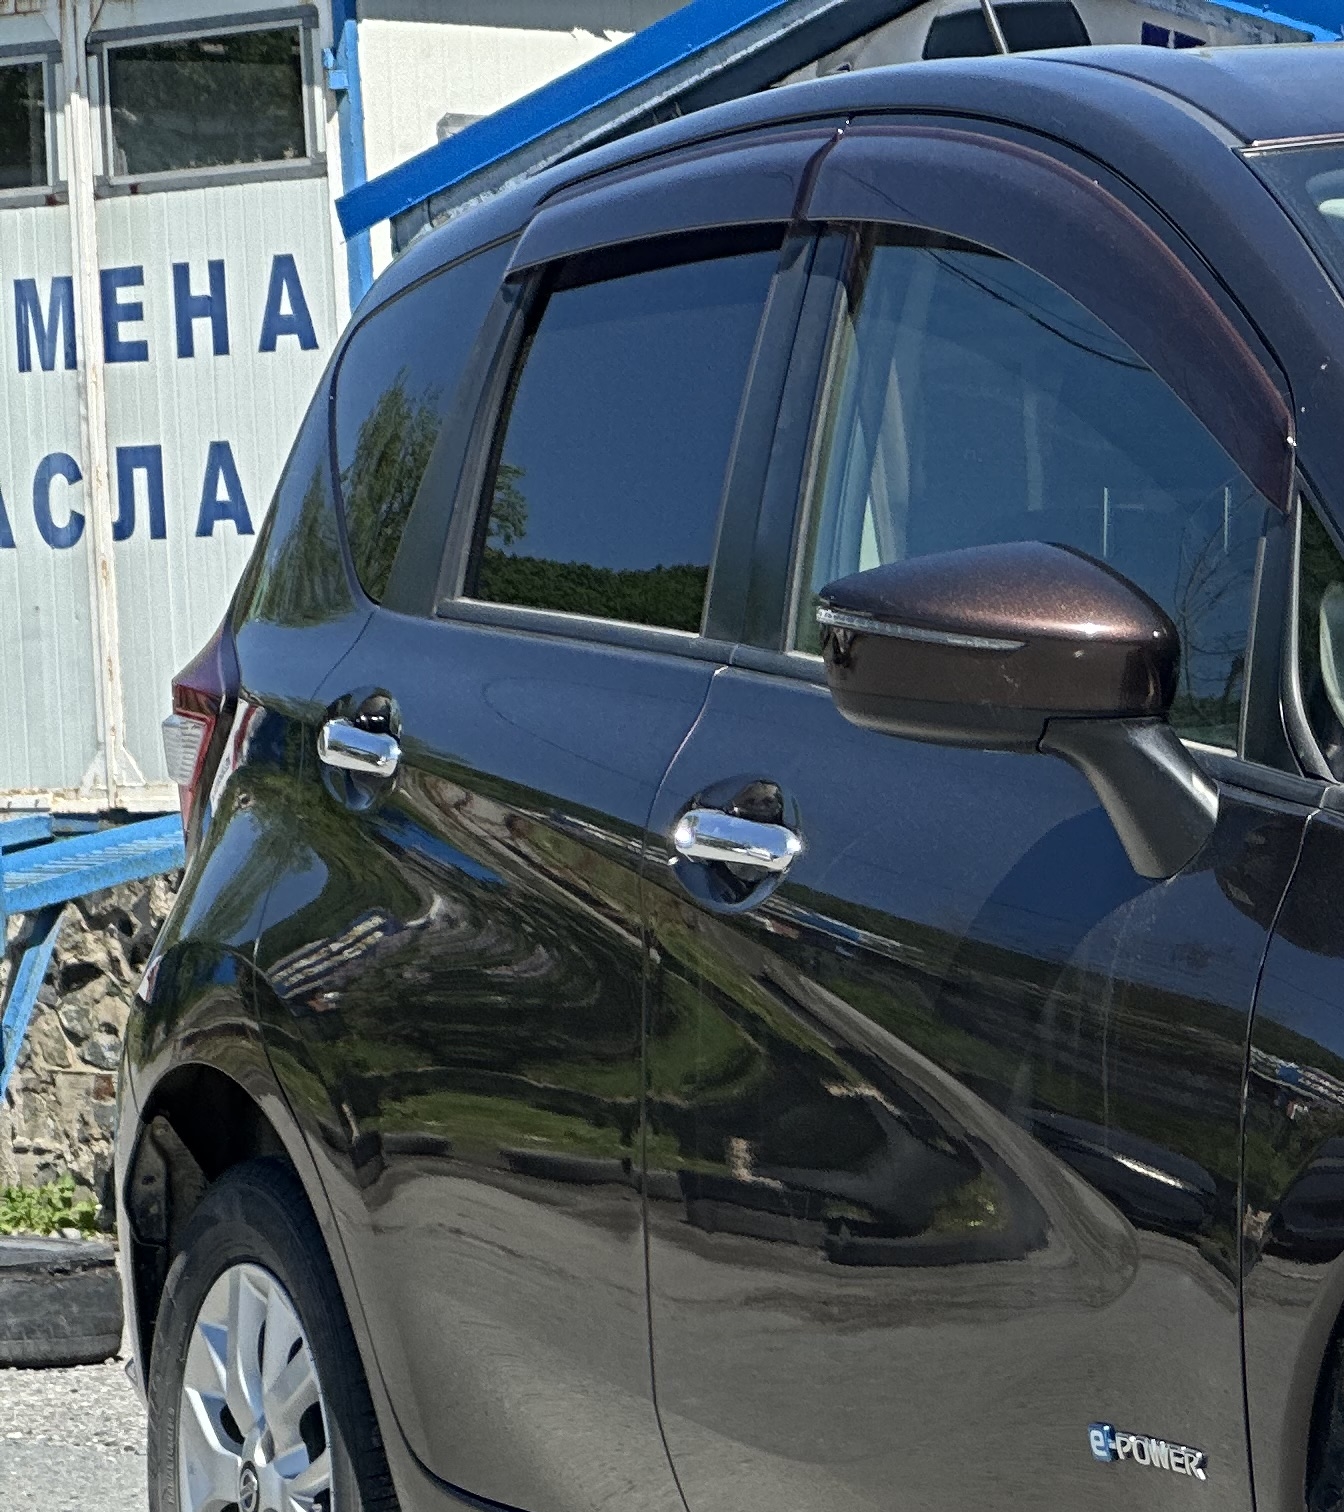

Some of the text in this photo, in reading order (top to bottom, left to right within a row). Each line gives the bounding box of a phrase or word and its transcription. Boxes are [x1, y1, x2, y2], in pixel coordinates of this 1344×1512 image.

[13, 253, 319, 373] МЕНА
[0, 440, 255, 550] СЛА
[1089, 1424, 1207, 1480] e-POWER
